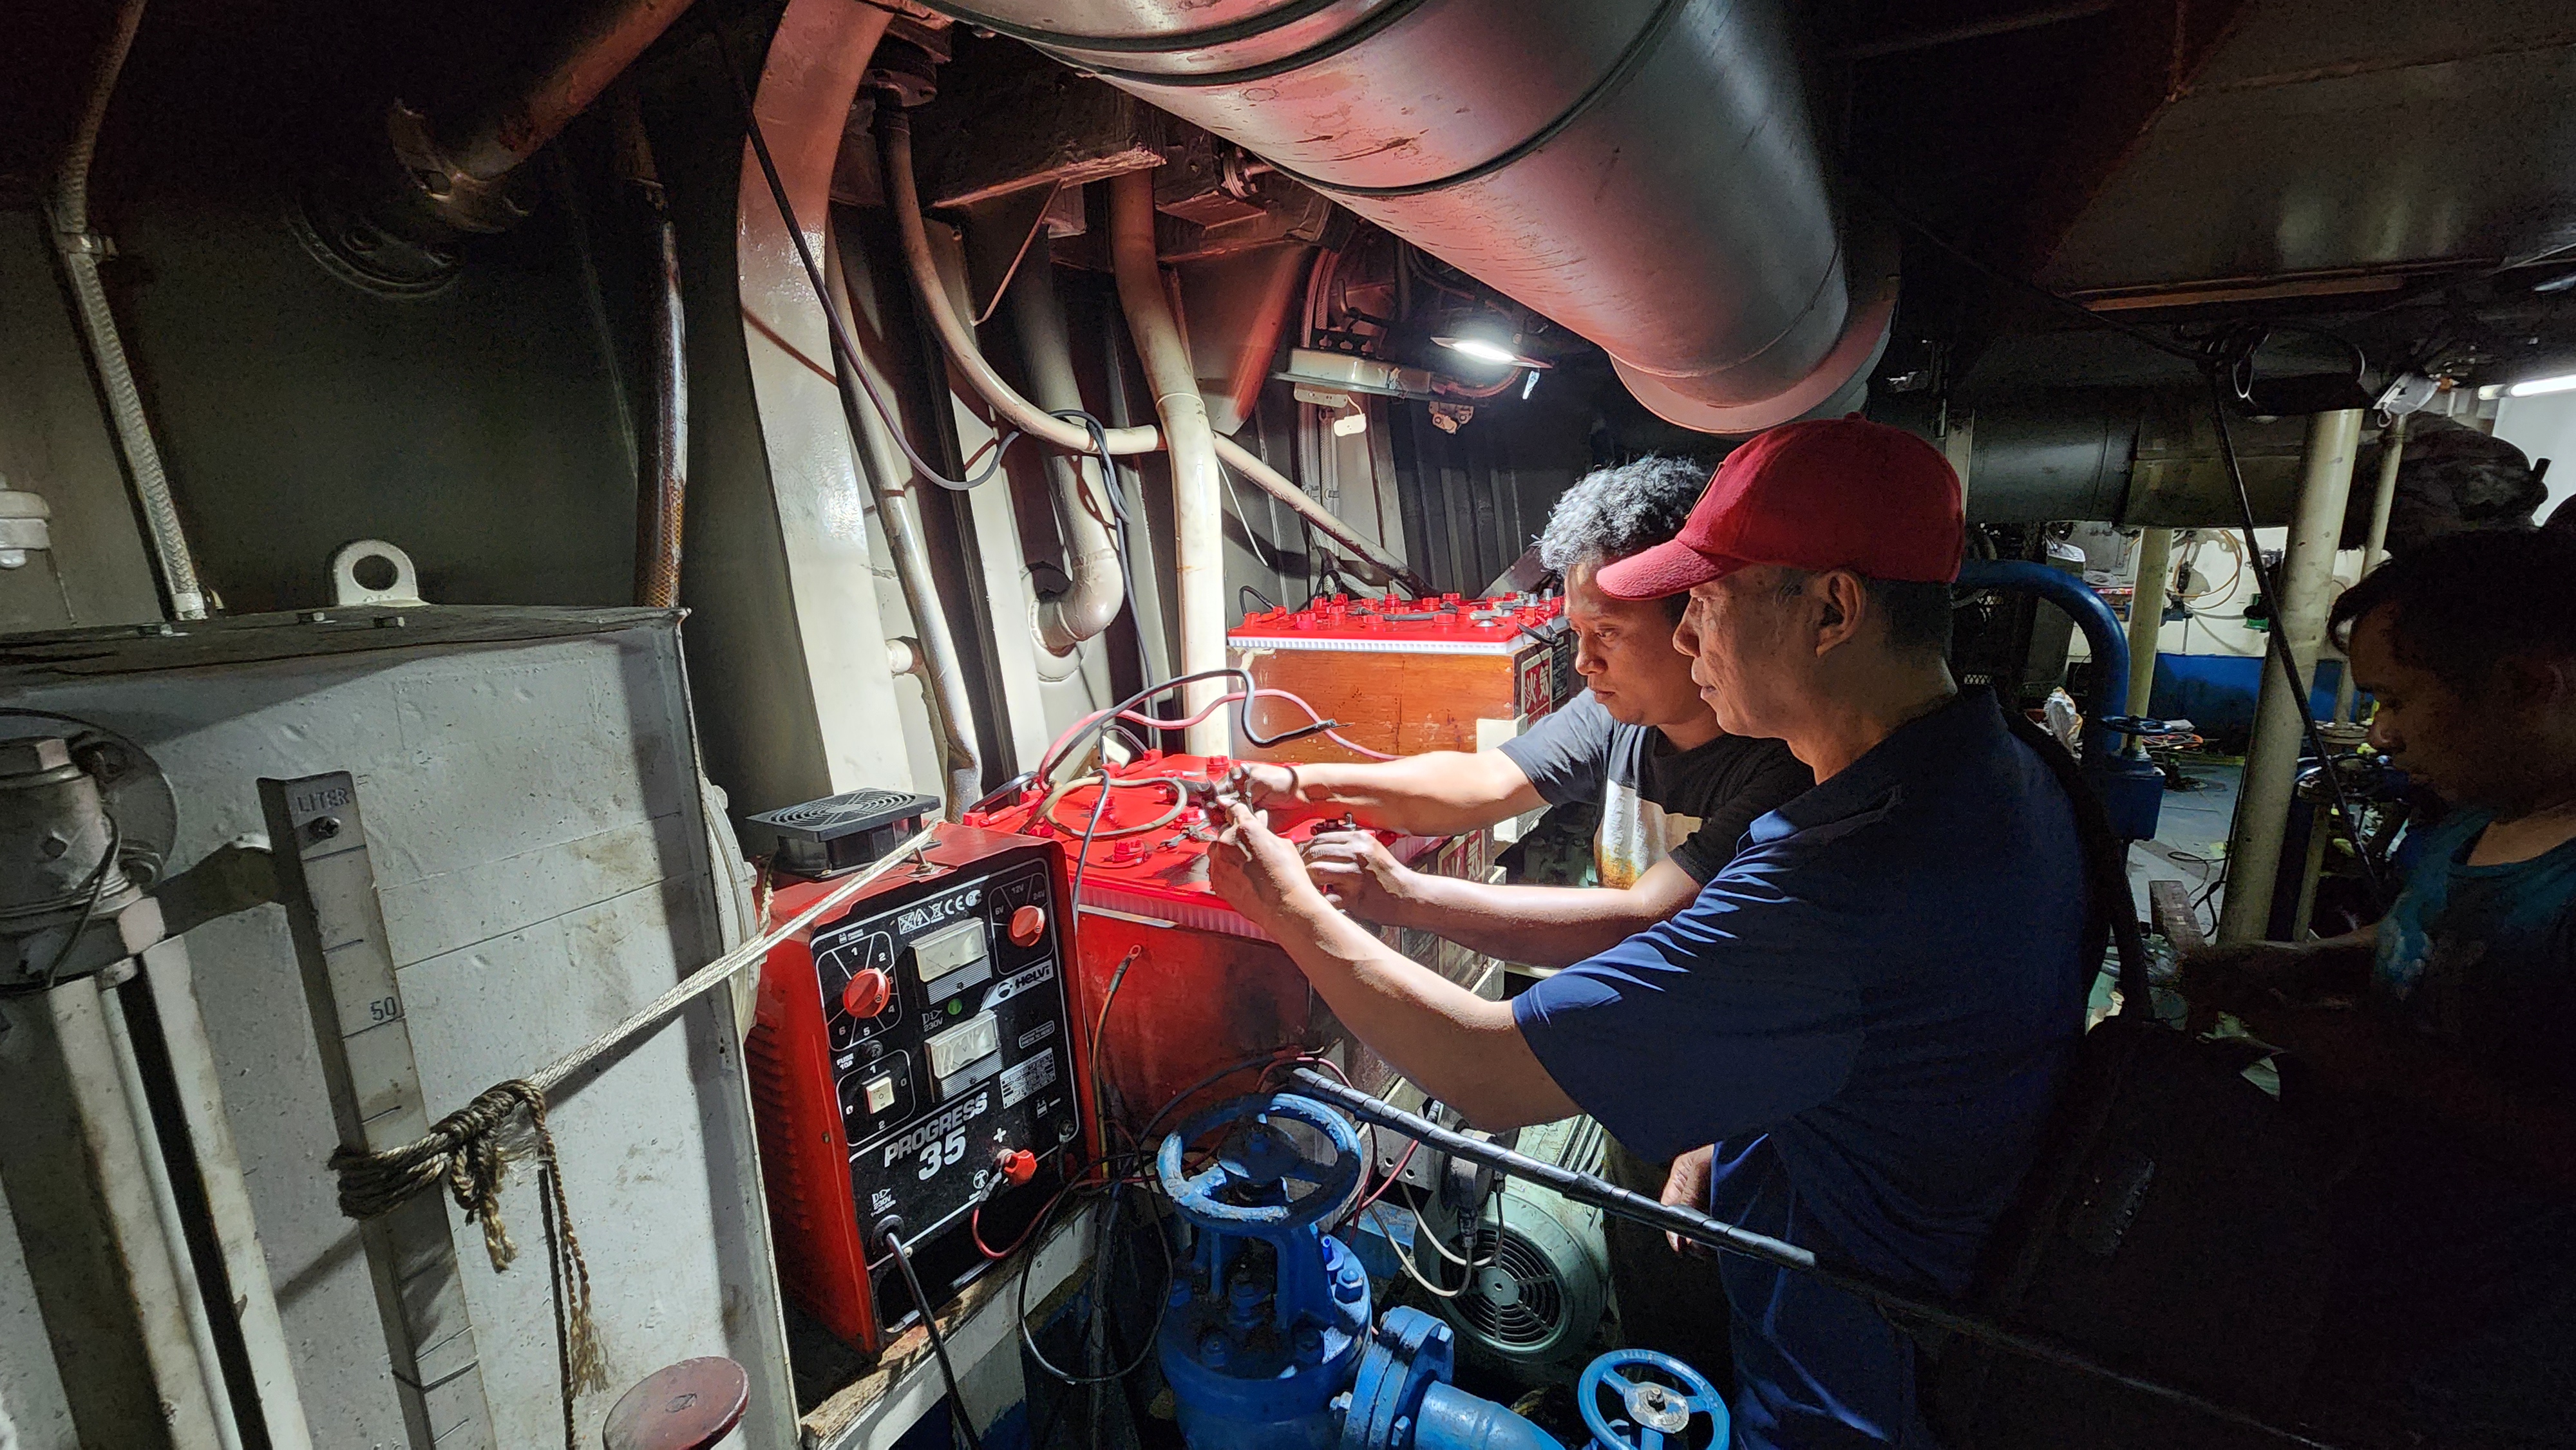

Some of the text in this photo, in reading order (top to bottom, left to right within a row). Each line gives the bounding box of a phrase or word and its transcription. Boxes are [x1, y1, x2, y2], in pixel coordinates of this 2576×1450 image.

[296, 787, 350, 814] LITER
[1011, 883, 1024, 894] 12V
[1033, 890, 1045, 900] 24V
[995, 905, 1004, 916] 6V
[851, 946, 858, 956] 1
[878, 952, 886, 962] 2
[889, 976, 894, 984] 3
[370, 996, 397, 1021] 50
[888, 1004, 895, 1013] 4
[923, 1017, 943, 1033] 230V
[839, 1026, 846, 1036] 6
[863, 1026, 870, 1036] 5
[837, 1053, 855, 1066] FUSE
[839, 1060, 854, 1070] 10A
[869, 1065, 876, 1073] 1
[900, 1078, 907, 1087] 0
[878, 1120, 886, 1130] 2
[884, 1091, 987, 1168] PROGRESS
[918, 1125, 967, 1181] 35
[873, 1194, 891, 1210] 230V
